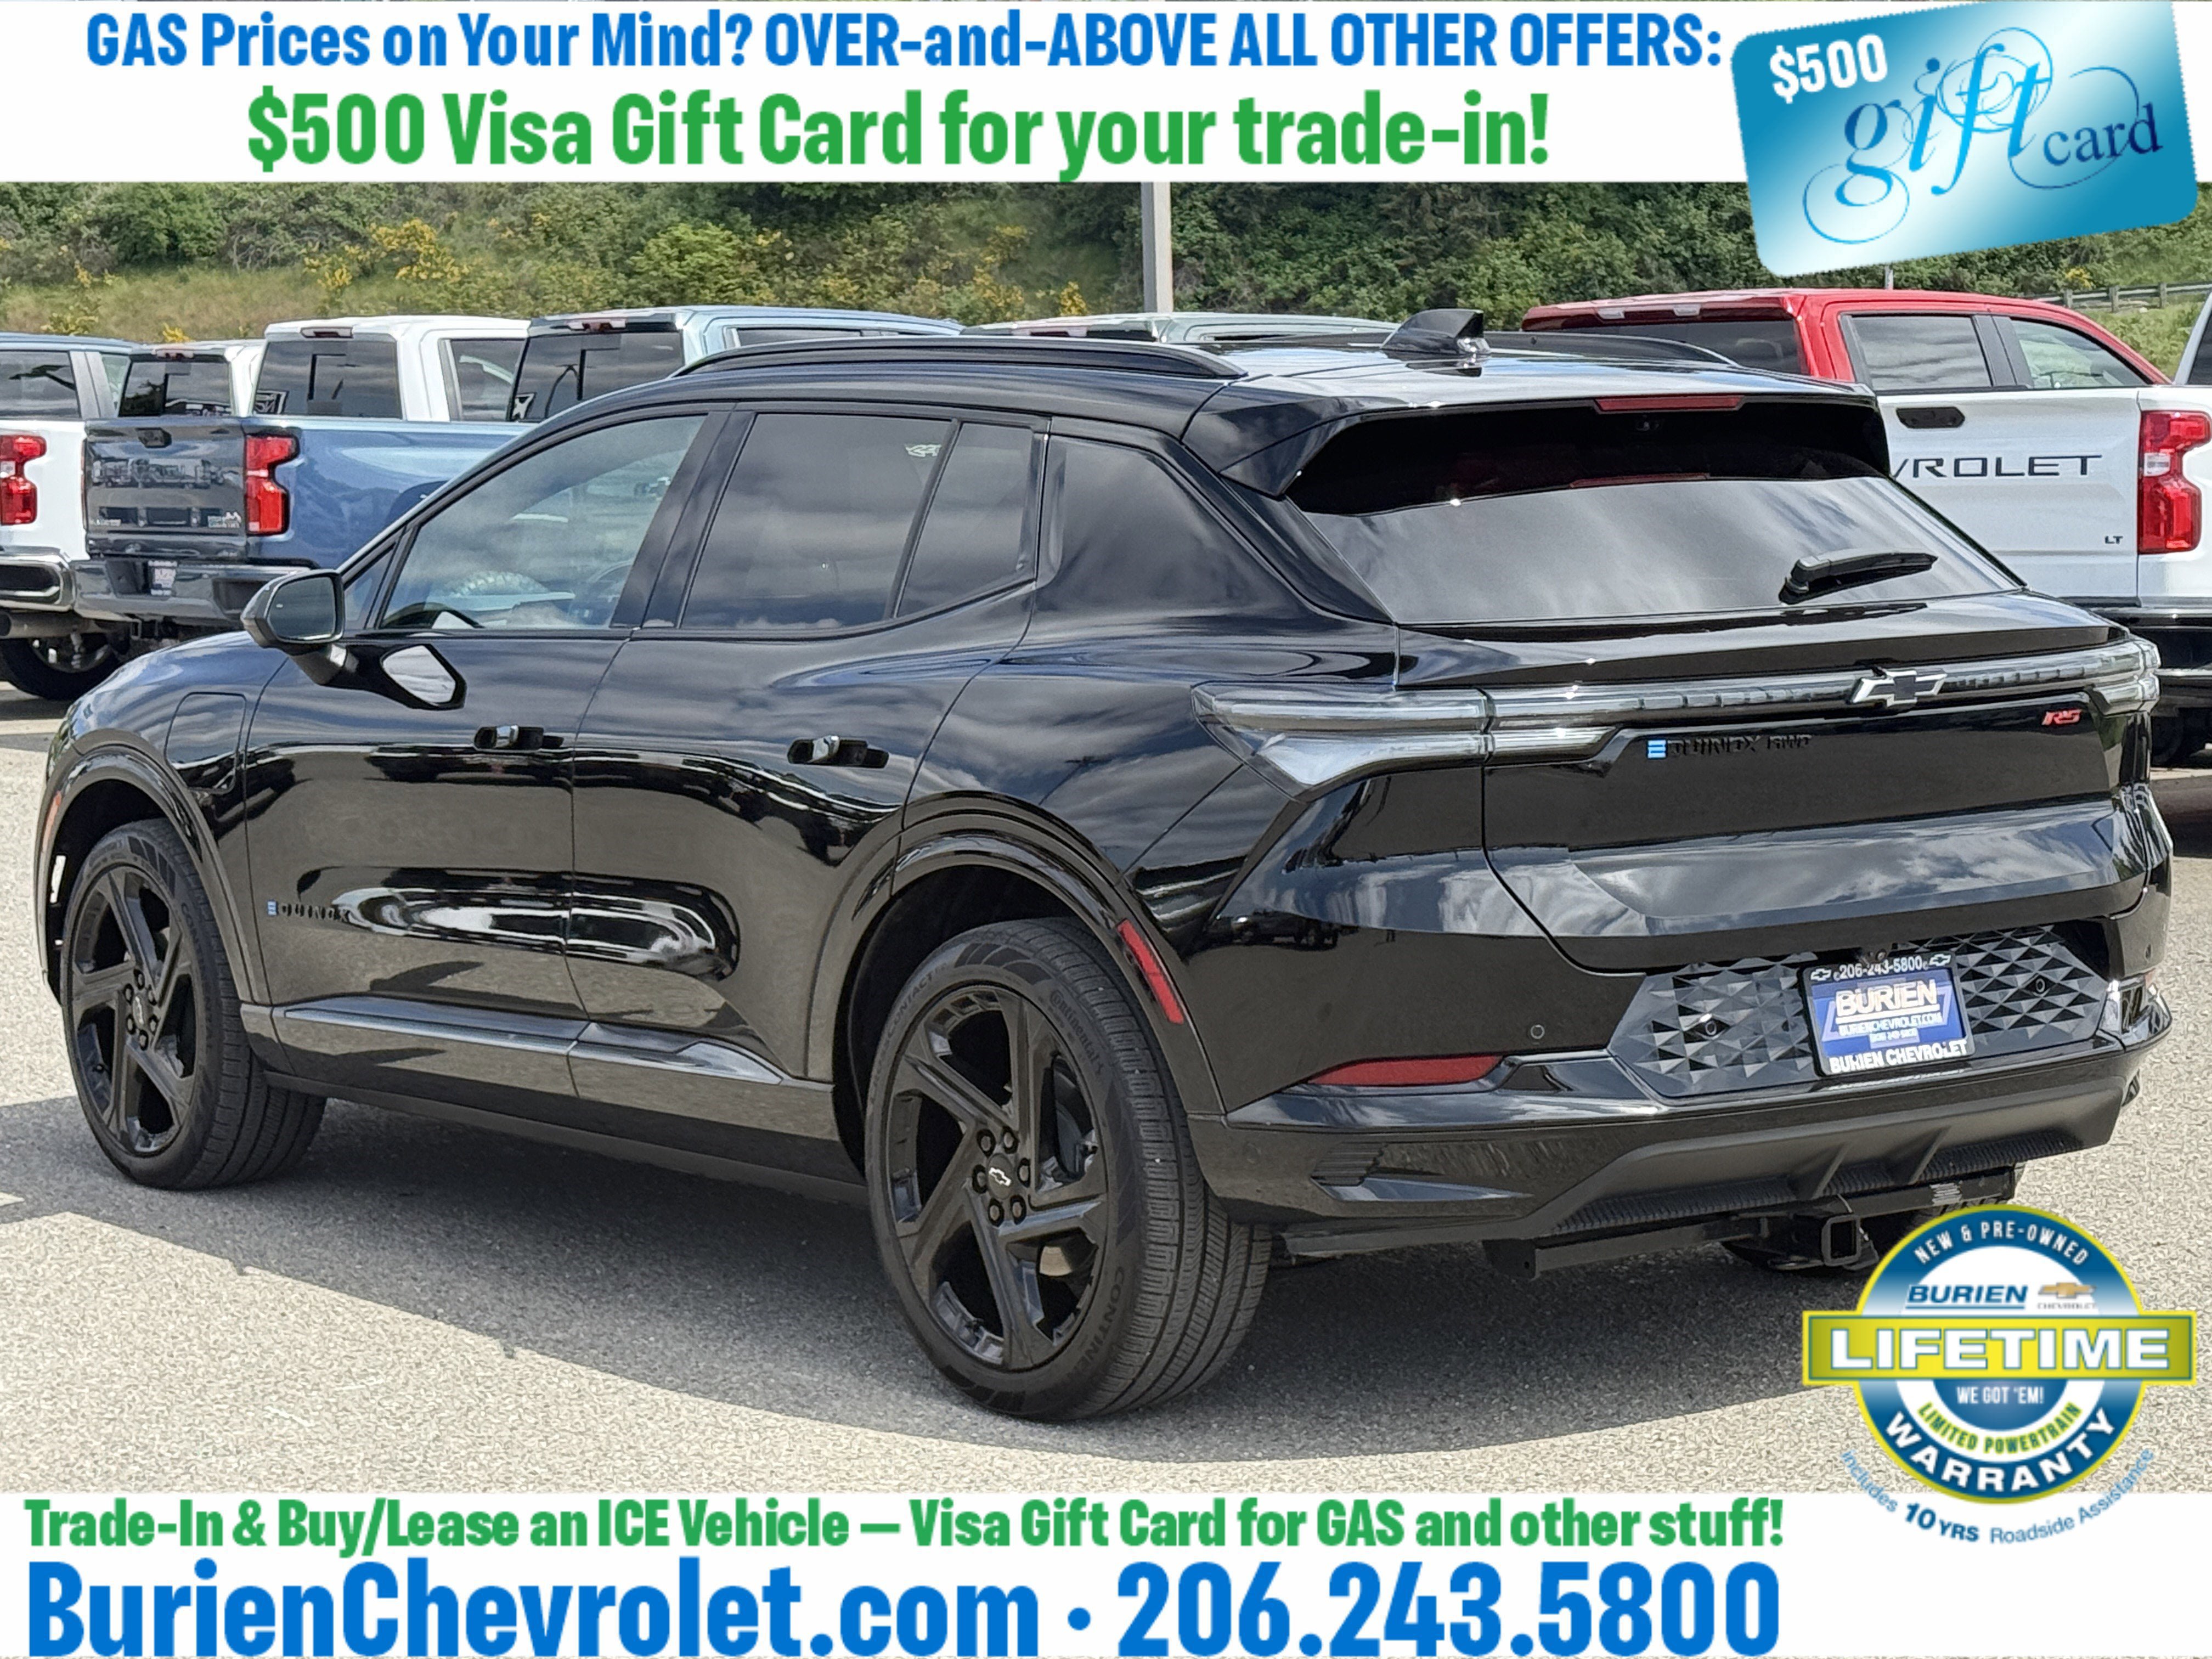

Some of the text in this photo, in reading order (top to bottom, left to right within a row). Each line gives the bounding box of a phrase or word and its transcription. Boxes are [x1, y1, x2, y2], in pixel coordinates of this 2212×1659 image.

[2105, 535, 2123, 544] LT
[2041, 708, 2081, 725] RS
[1839, 955, 1923, 979] 206-243-5800
[1835, 979, 1937, 1017] BURIEN
[1830, 1040, 1968, 1073] BURIEN CHEVROLET
